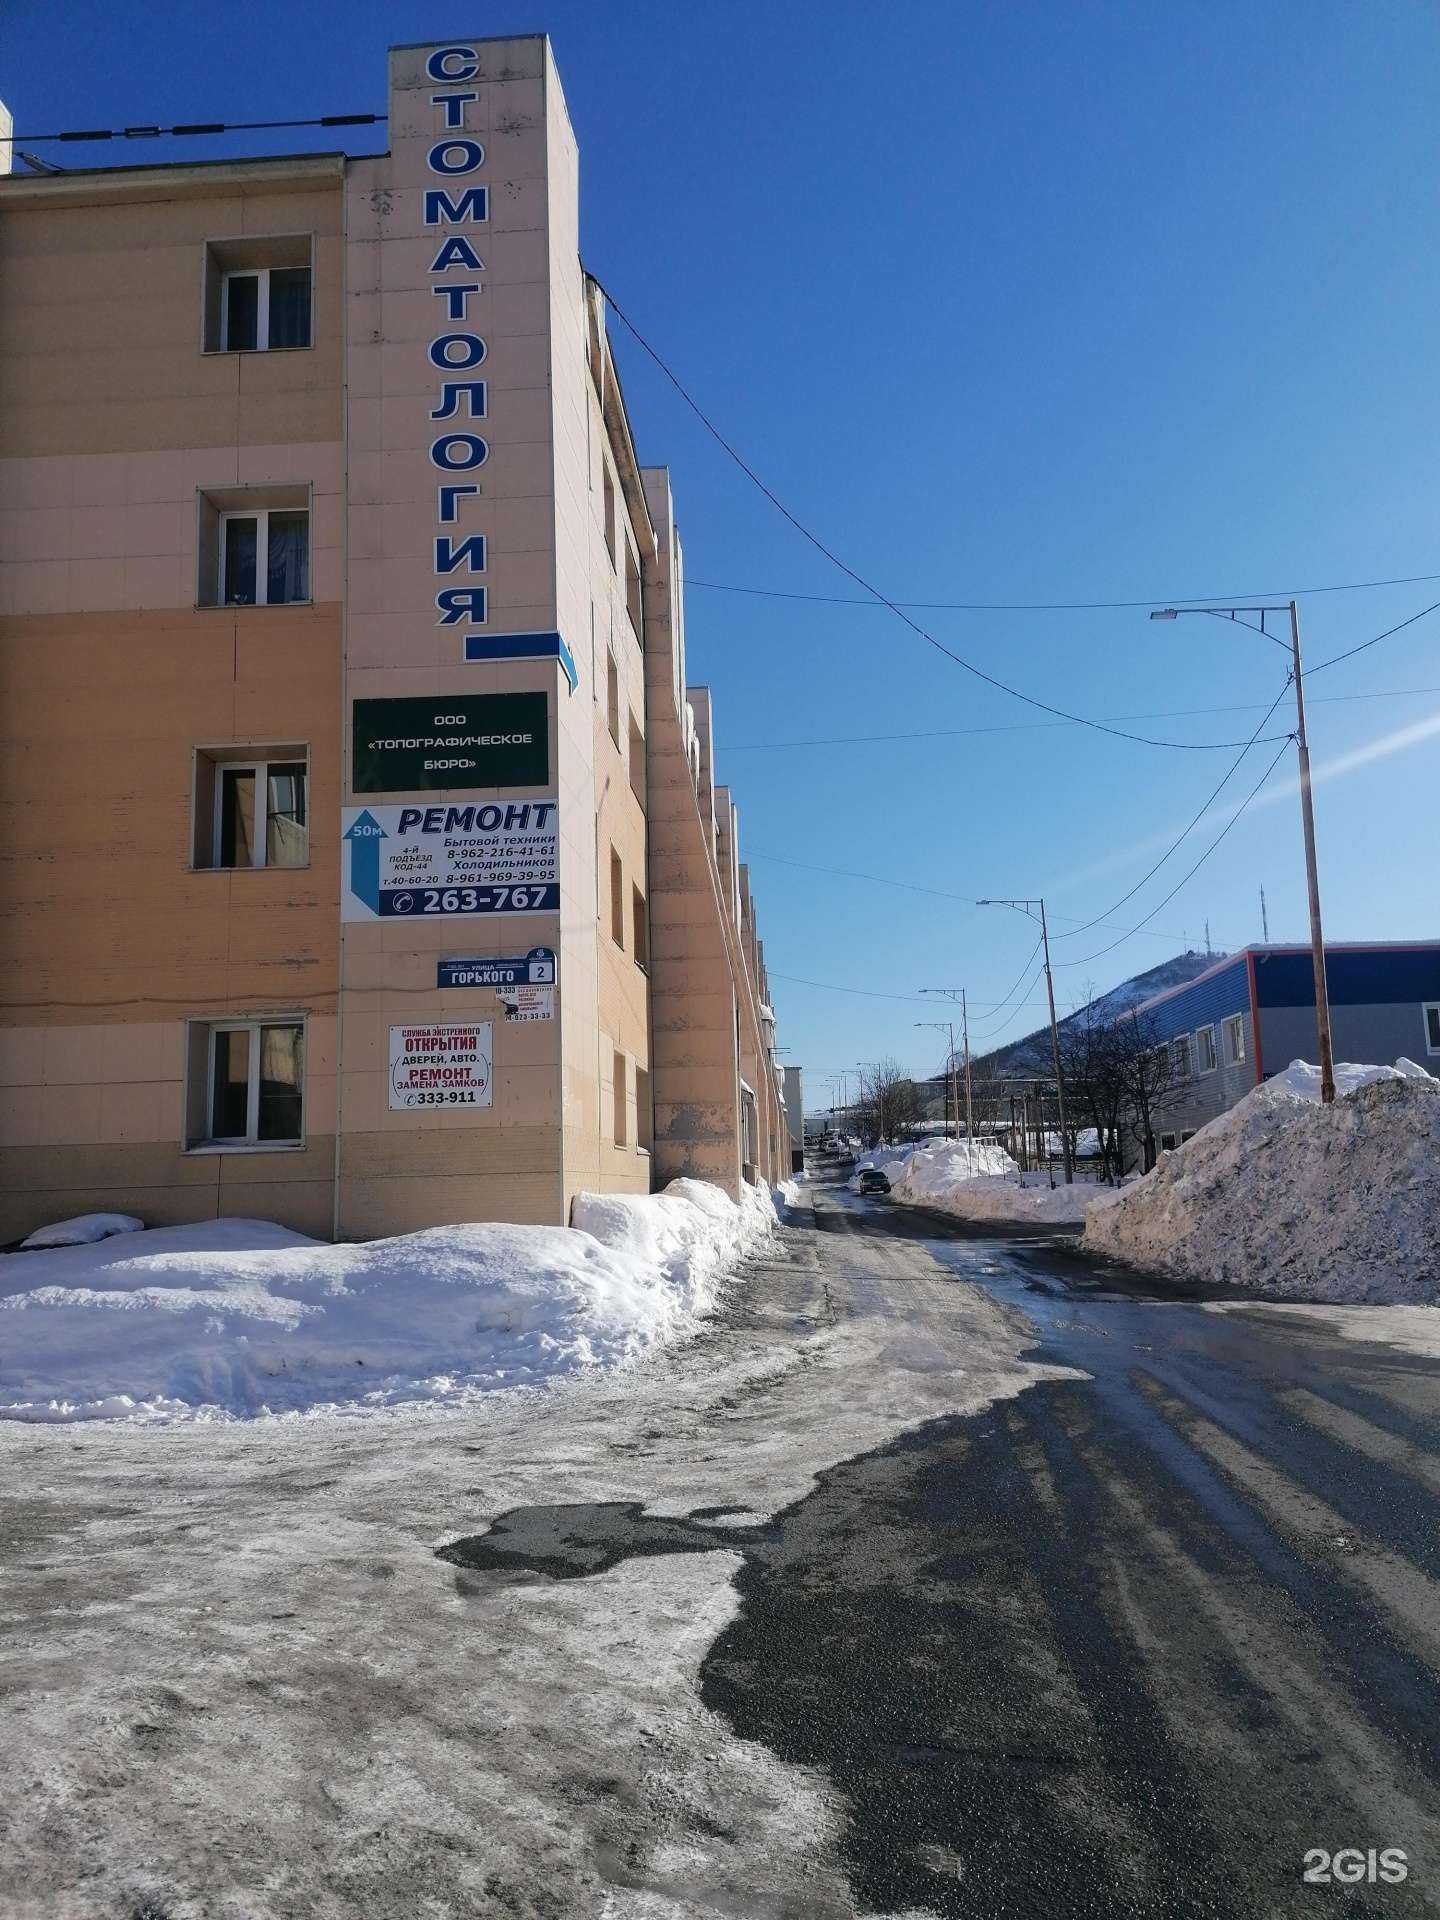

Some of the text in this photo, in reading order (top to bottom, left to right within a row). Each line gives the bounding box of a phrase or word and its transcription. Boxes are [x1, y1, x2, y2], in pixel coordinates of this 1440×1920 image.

[423, 44, 489, 627] СТОМАТОЛОГИЯ
[434, 715, 466, 725] ООО
[368, 734, 532, 750] «ТОПОГРАФИЧЕСКОЕ
[424, 759, 476, 770] БЮРО»
[398, 803, 557, 836] РЕМОНТ
[444, 835, 556, 847] Бытовой техники
[389, 854, 433, 863] ПОДЪЕЗД
[447, 846, 555, 859] 8-962-216-41-61
[394, 863, 428, 871] КОД-44
[453, 859, 555, 870] Холодильников
[446, 871, 555, 884] 8-961-969-39-95
[423, 887, 548, 912] 263-767
[451, 970, 514, 984] ГОРЬКОГО
[537, 967, 545, 978] 2
[401, 1027, 481, 1038] СЛУЖБА ЭКСТРЕННОГО
[405, 1036, 477, 1053] ОТКРЫТИЯ
[402, 1053, 480, 1066] ДВЕРЕЙ, АВТО.
[409, 1068, 473, 1081] РЕМОНТ
[397, 1079, 485, 1090] ЗАМЕНА ЗАМКОВ
[417, 1091, 476, 1104] 333-911
